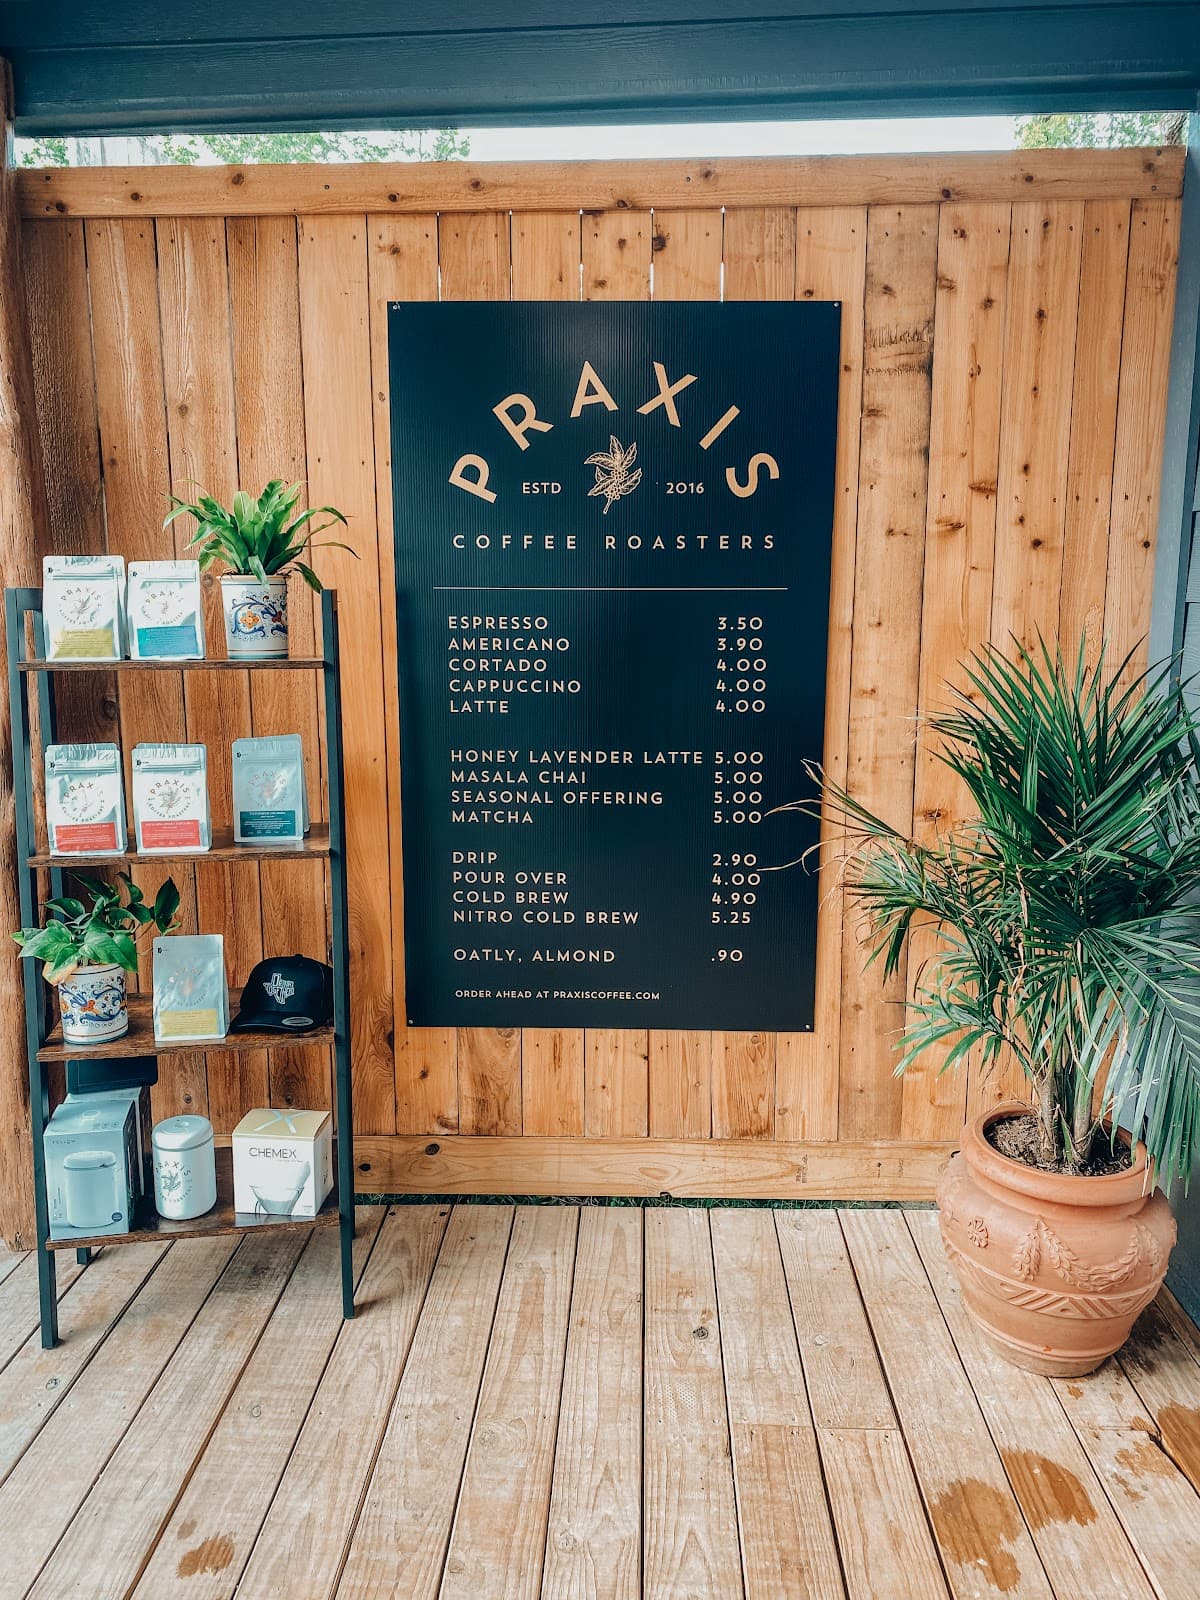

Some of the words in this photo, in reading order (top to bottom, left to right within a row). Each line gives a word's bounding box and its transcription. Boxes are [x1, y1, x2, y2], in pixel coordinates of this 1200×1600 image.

[448, 360, 780, 504] PRAXIS
[522, 482, 562, 494] ESTD
[666, 482, 705, 494] 2016
[452, 534, 577, 550] COFFEE
[605, 534, 774, 550] ROASTERS
[448, 615, 548, 630] ESPRESSO
[717, 616, 763, 631] 3.50
[447, 637, 570, 652] AMERICANO
[717, 637, 763, 651] 3.90
[448, 658, 547, 672] CORTADO
[716, 658, 767, 672] 4.00
[449, 679, 581, 693] CAPPUCCINO
[716, 678, 766, 692] 4.00
[450, 699, 509, 714] LATTE
[715, 699, 766, 713] 4.00
[451, 749, 519, 763] HONEY
[529, 750, 633, 764] LAVENDER
[644, 751, 703, 764] LATTE
[714, 751, 764, 765] 5.00
[451, 770, 529, 784] MASALA
[538, 770, 586, 784] CHAI
[714, 771, 763, 785] 5.00
[63, 781, 104, 798] PRAXS
[150, 778, 190, 794] PRAXIS
[451, 790, 554, 804] SEASONAL
[563, 791, 663, 805] OFFERING
[713, 791, 763, 804] 5.00
[452, 810, 533, 824] MATCHA
[713, 810, 762, 824] 5.00
[452, 851, 498, 864] DRIP
[711, 852, 758, 867] 2.90
[453, 871, 505, 884] POUR
[514, 871, 567, 885] OVER
[711, 872, 761, 886] 4.00
[452, 890, 505, 904] COLD
[515, 891, 569, 905] BREW
[711, 892, 757, 905] 4.90
[453, 910, 513, 923] NITRO
[522, 910, 576, 924] COLD
[585, 911, 639, 924] BREW
[711, 911, 751, 924] 5.25
[453, 948, 522, 963] OATLY,
[531, 949, 615, 963] ALMOND
[711, 949, 743, 962] .90
[455, 989, 492, 998] ORDER
[495, 990, 532, 999] AHEAD
[535, 990, 550, 999] AT
[553, 990, 660, 1000] PRAXISCOFFEE.COM
[248, 1147, 297, 1159] CHEMEX
